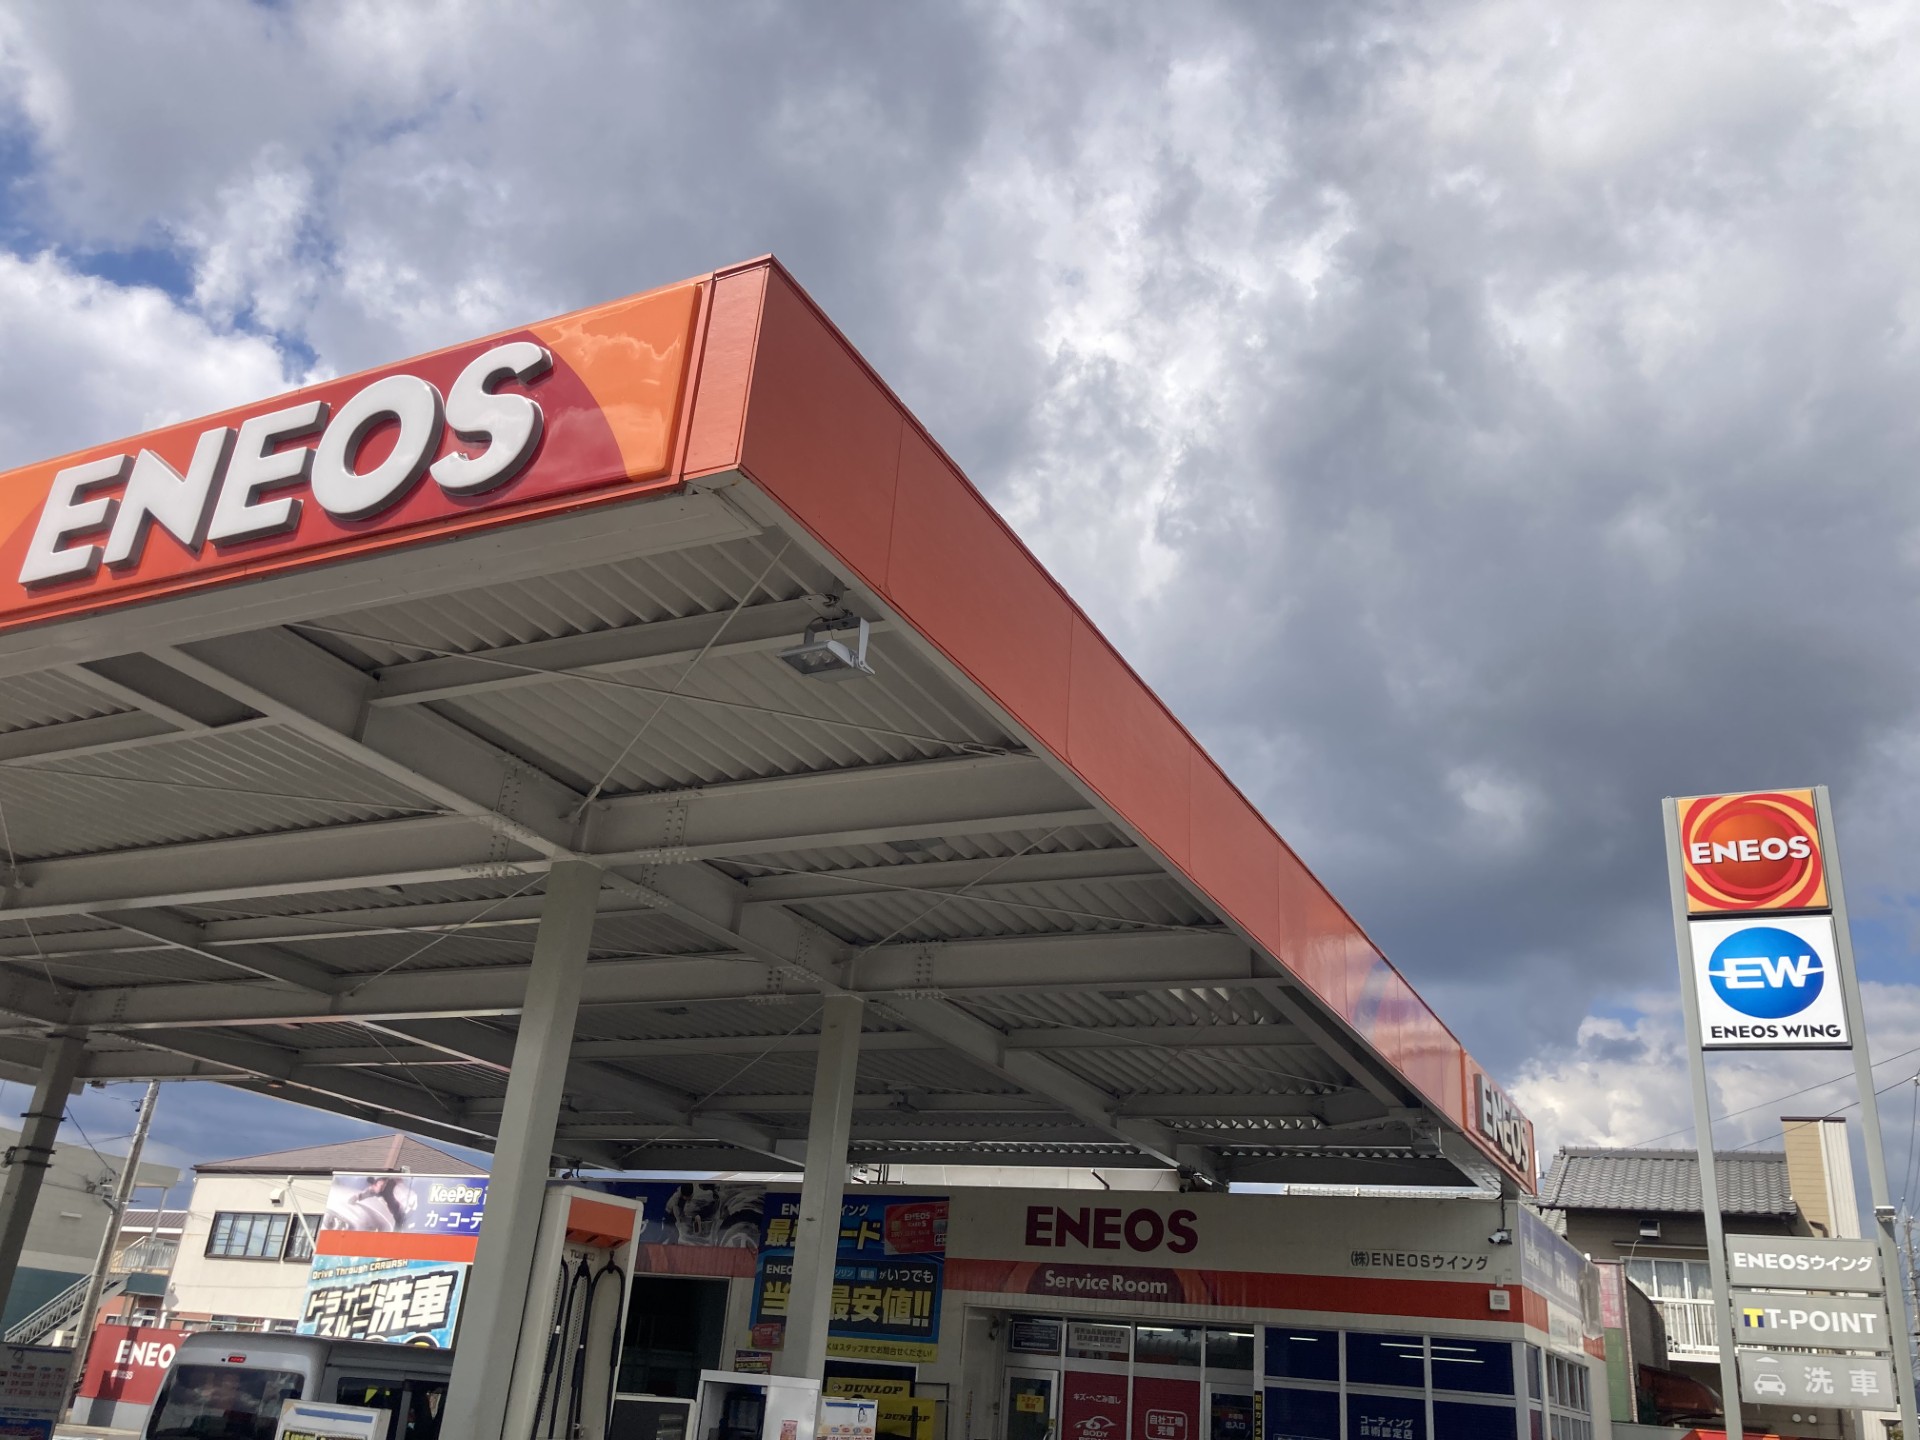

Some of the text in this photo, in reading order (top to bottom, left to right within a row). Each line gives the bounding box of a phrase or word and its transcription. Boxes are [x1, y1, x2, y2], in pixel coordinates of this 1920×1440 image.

[18, 341, 552, 589] ENEOS
[1690, 835, 1811, 865] ENEOS
[1711, 1024, 1842, 1039] ENEOS WING
[1476, 1073, 1530, 1173] ENEOS
[429, 1184, 482, 1205] KeePer
[1025, 1205, 1199, 1254] ENEOS
[312, 1267, 334, 1280] Drive
[336, 1263, 368, 1276] Through
[1732, 1251, 1874, 1273] ENEOSウイング
[879, 1267, 934, 1284] がいつでも
[1045, 1270, 1168, 1294] Service Room
[366, 1275, 454, 1334] 洗車
[1764, 1308, 1878, 1335] T-POINT
[843, 1383, 904, 1395] DUNLOP
[1803, 1366, 1880, 1397] 洗車
[1083, 1429, 1109, 1438] BODY
